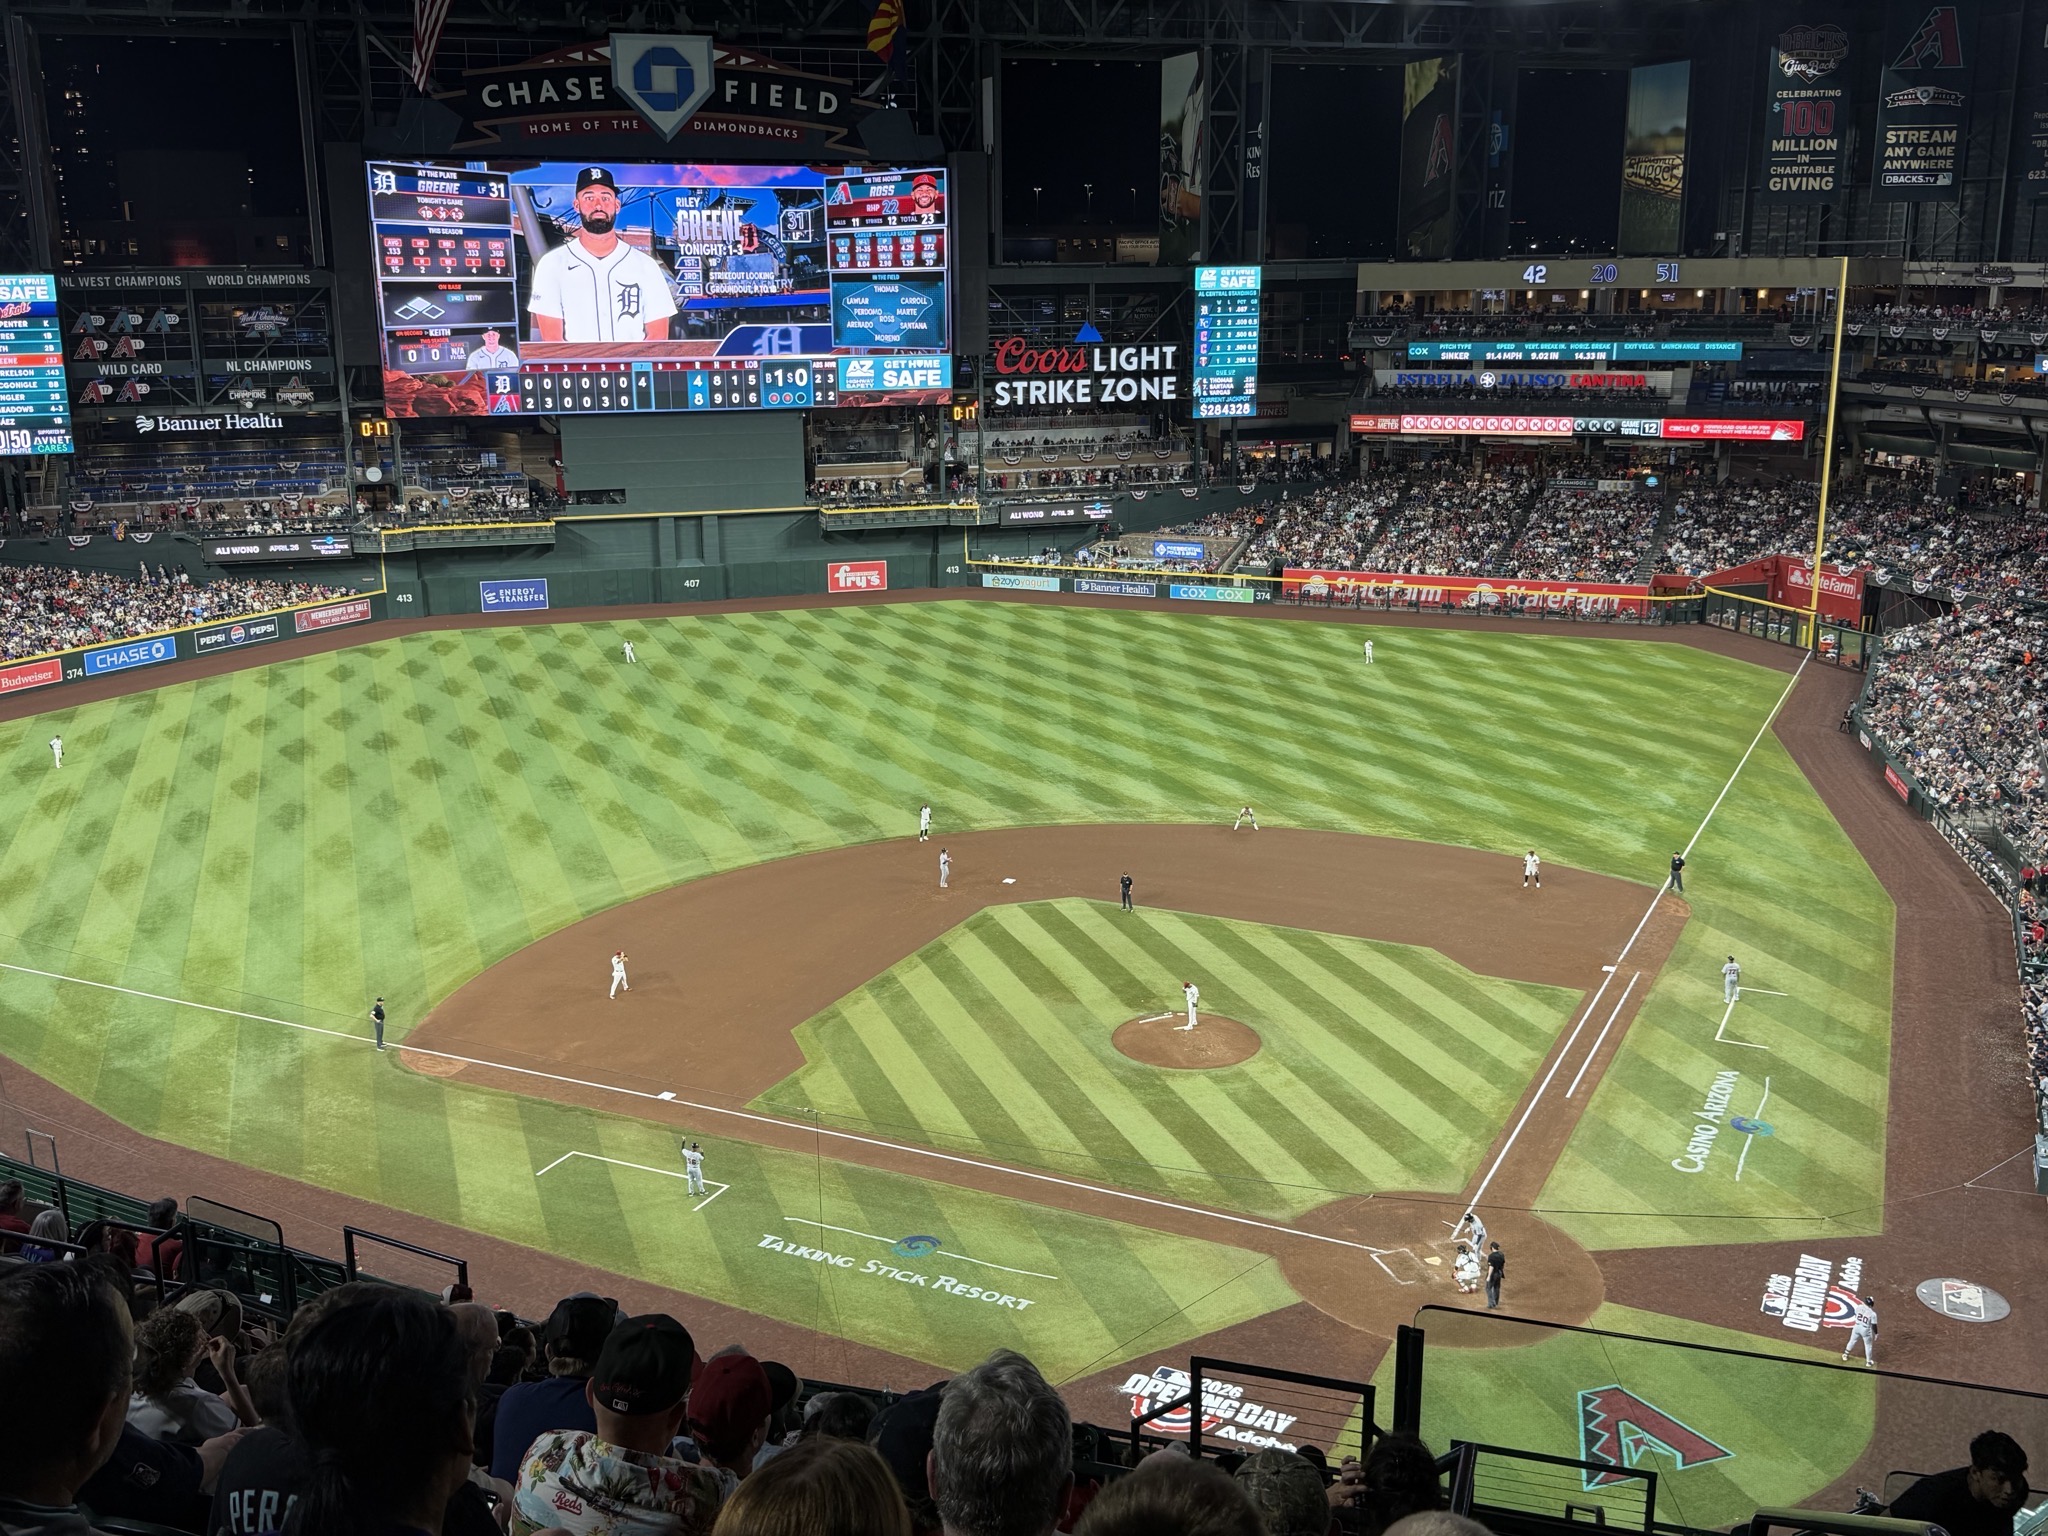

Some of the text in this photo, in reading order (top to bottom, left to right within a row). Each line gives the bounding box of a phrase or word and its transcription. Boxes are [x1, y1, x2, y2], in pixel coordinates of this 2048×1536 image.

[1785, 59, 1836, 73] Give Back
[482, 77, 838, 114] CHASE FIELD
[1777, 90, 1841, 98] CELEBRATING
[1773, 101, 1834, 136] $100
[529, 119, 798, 139] HOME OF THE DIAMONDBACKS
[1886, 130, 1957, 144] STREAM
[1772, 139, 1837, 151] MILLION
[1797, 154, 1809, 163] IN
[1885, 147, 1954, 157] ANY GAME
[1626, 157, 1679, 185] Slugger
[1771, 166, 1834, 174] CHARITABLE
[1883, 160, 1953, 169] ANYWHERE
[1769, 177, 1833, 191] GIVING
[1886, 175, 1934, 184] DBACKS.TV
[418, 181, 505, 197] GREENE LF 31
[870, 185, 895, 197] ROSS
[417, 197, 446, 205] TONIGHT'S
[676, 197, 700, 208] RILEY
[866, 199, 899, 214] RHP 22
[676, 209, 744, 240] GREENE
[787, 211, 804, 230] 31
[852, 218, 859, 227] 11
[888, 216, 897, 225] 12
[921, 214, 934, 224] 23
[680, 243, 743, 256] TONIGHT: 1-3
[761, 232, 787, 259] TIGERS
[207, 274, 310, 285] WORLD CHAMPIONS
[684, 272, 774, 280] 3RD: STRIKEOUT LOOKING
[1523, 265, 1547, 284] 42
[1590, 263, 1679, 283] 20 51
[61, 276, 181, 287] NL WEST CHAMPIONS
[1220, 276, 1255, 288] SAFE
[0, 286, 49, 299] SAFE
[995, 337, 1177, 374] Coors LIGHT
[1409, 348, 1429, 356] COX
[1441, 352, 1470, 360] SINKER
[1486, 352, 1522, 360] 91.4 MPH
[1531, 352, 1559, 360] 9.02 IN
[98, 364, 162, 375] WILD CARD
[226, 360, 312, 372] NL CHAMPIONS
[883, 370, 942, 387] SAFE
[1397, 374, 1566, 387] ESTRELLA JALISCO
[1570, 374, 1646, 387] CANTINA
[995, 376, 1176, 405] STRIKE ZONE
[953, 407, 975, 420] 0:17
[1200, 403, 1250, 417] $284328
[157, 413, 283, 432] Banner Health
[1643, 423, 1657, 434] 12
[361, 422, 388, 437] 0:17
[34, 436, 71, 445] AVNET
[232, 546, 259, 554] WONG
[834, 565, 880, 588] fry's
[946, 566, 959, 574] 413
[499, 587, 536, 596] ENERGY
[1090, 583, 1150, 595] Banner Health
[1180, 588, 1243, 600] COX COX
[396, 594, 412, 603] 413
[500, 593, 545, 603] TRANSFER
[1256, 592, 1270, 600] 374
[311, 603, 367, 620] MEMBERSHIPS ON SALE
[200, 634, 225, 645] PEPSI
[250, 624, 274, 635] PEPSI
[96, 646, 150, 668] CHASE
[1, 670, 53, 688] Budweiser
[67, 668, 83, 679] 374
[1671, 1071, 1740, 1173] CASINO ARIZONA
[757, 1234, 1036, 1311] TALKING STICK RESORT
[1838, 1257, 1863, 1292] Adobe
[1783, 1254, 1832, 1332] OPENING DAY
[1857, 1313, 1868, 1323] 20
[1201, 1378, 1243, 1399] 2026
[1122, 1373, 1297, 1433] OPENNG DAY
[552, 1491, 582, 1516] Reds
